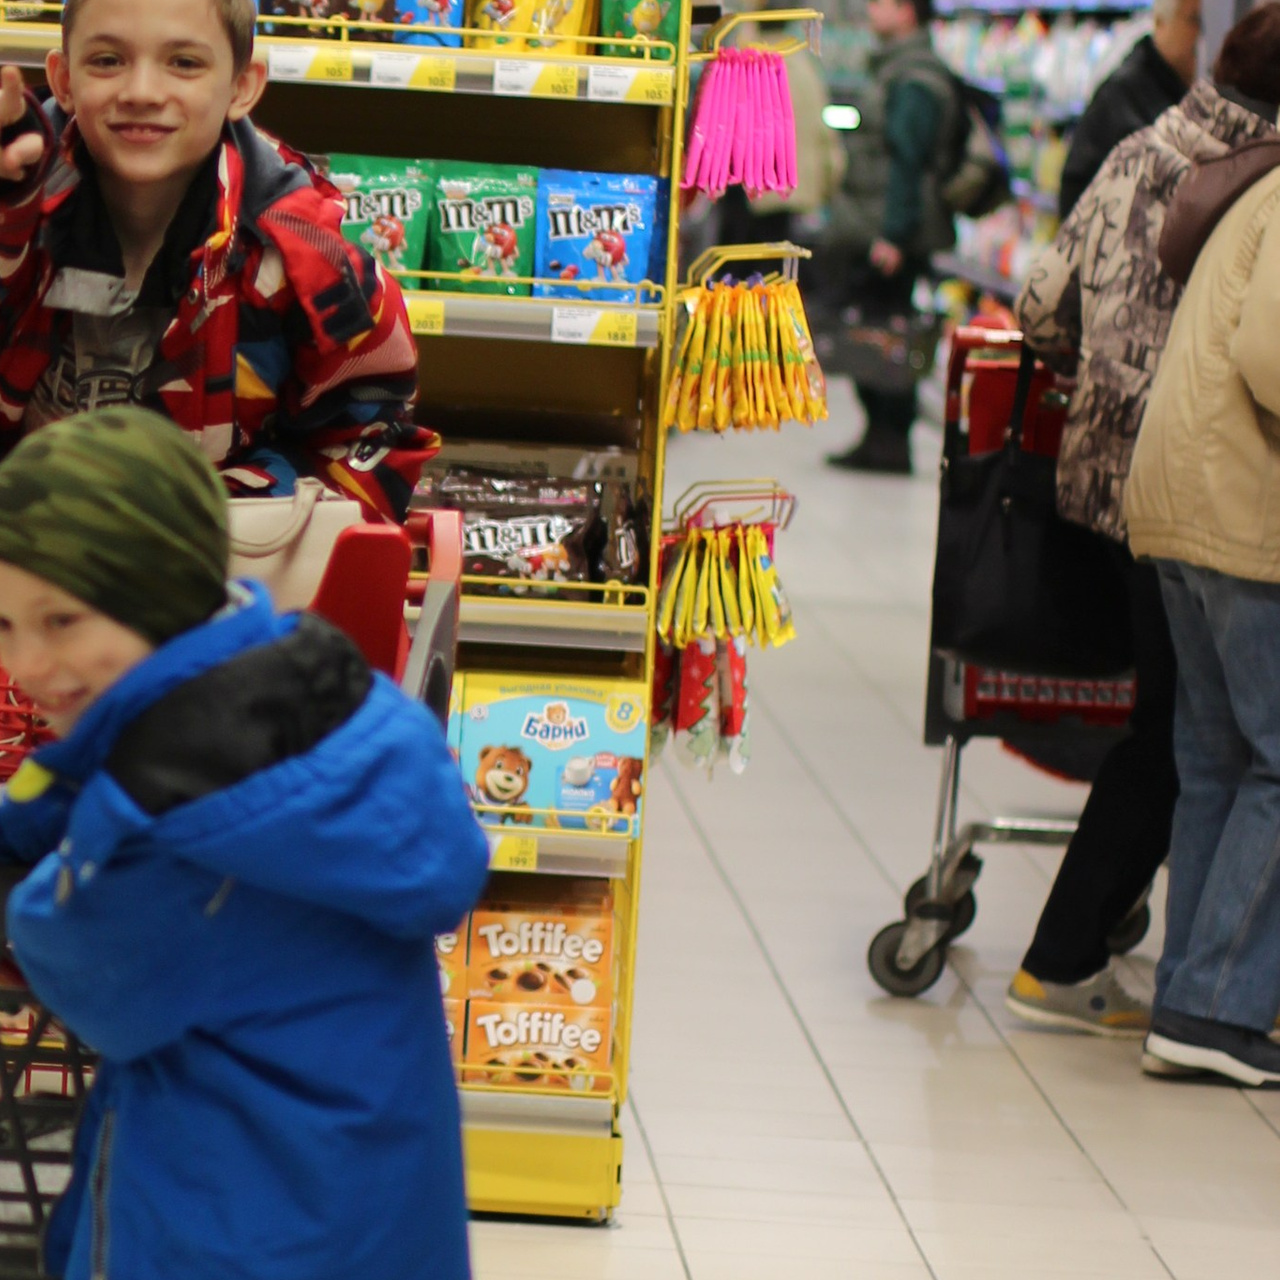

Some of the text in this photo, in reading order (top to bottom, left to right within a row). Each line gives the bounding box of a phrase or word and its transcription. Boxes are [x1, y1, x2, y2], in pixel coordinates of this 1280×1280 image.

[325, 67, 344, 78] 105
[428, 72, 446, 84] 105
[550, 83, 569, 95] 105
[645, 89, 663, 101] 105
[414, 319, 435, 331] 203
[607, 330, 627, 342] 188
[616, 702, 633, 721] 8
[524, 716, 587, 741] Барни
[509, 856, 528, 866] 199
[478, 922, 605, 964] Toffifee
[476, 1012, 602, 1053] Toffifee
